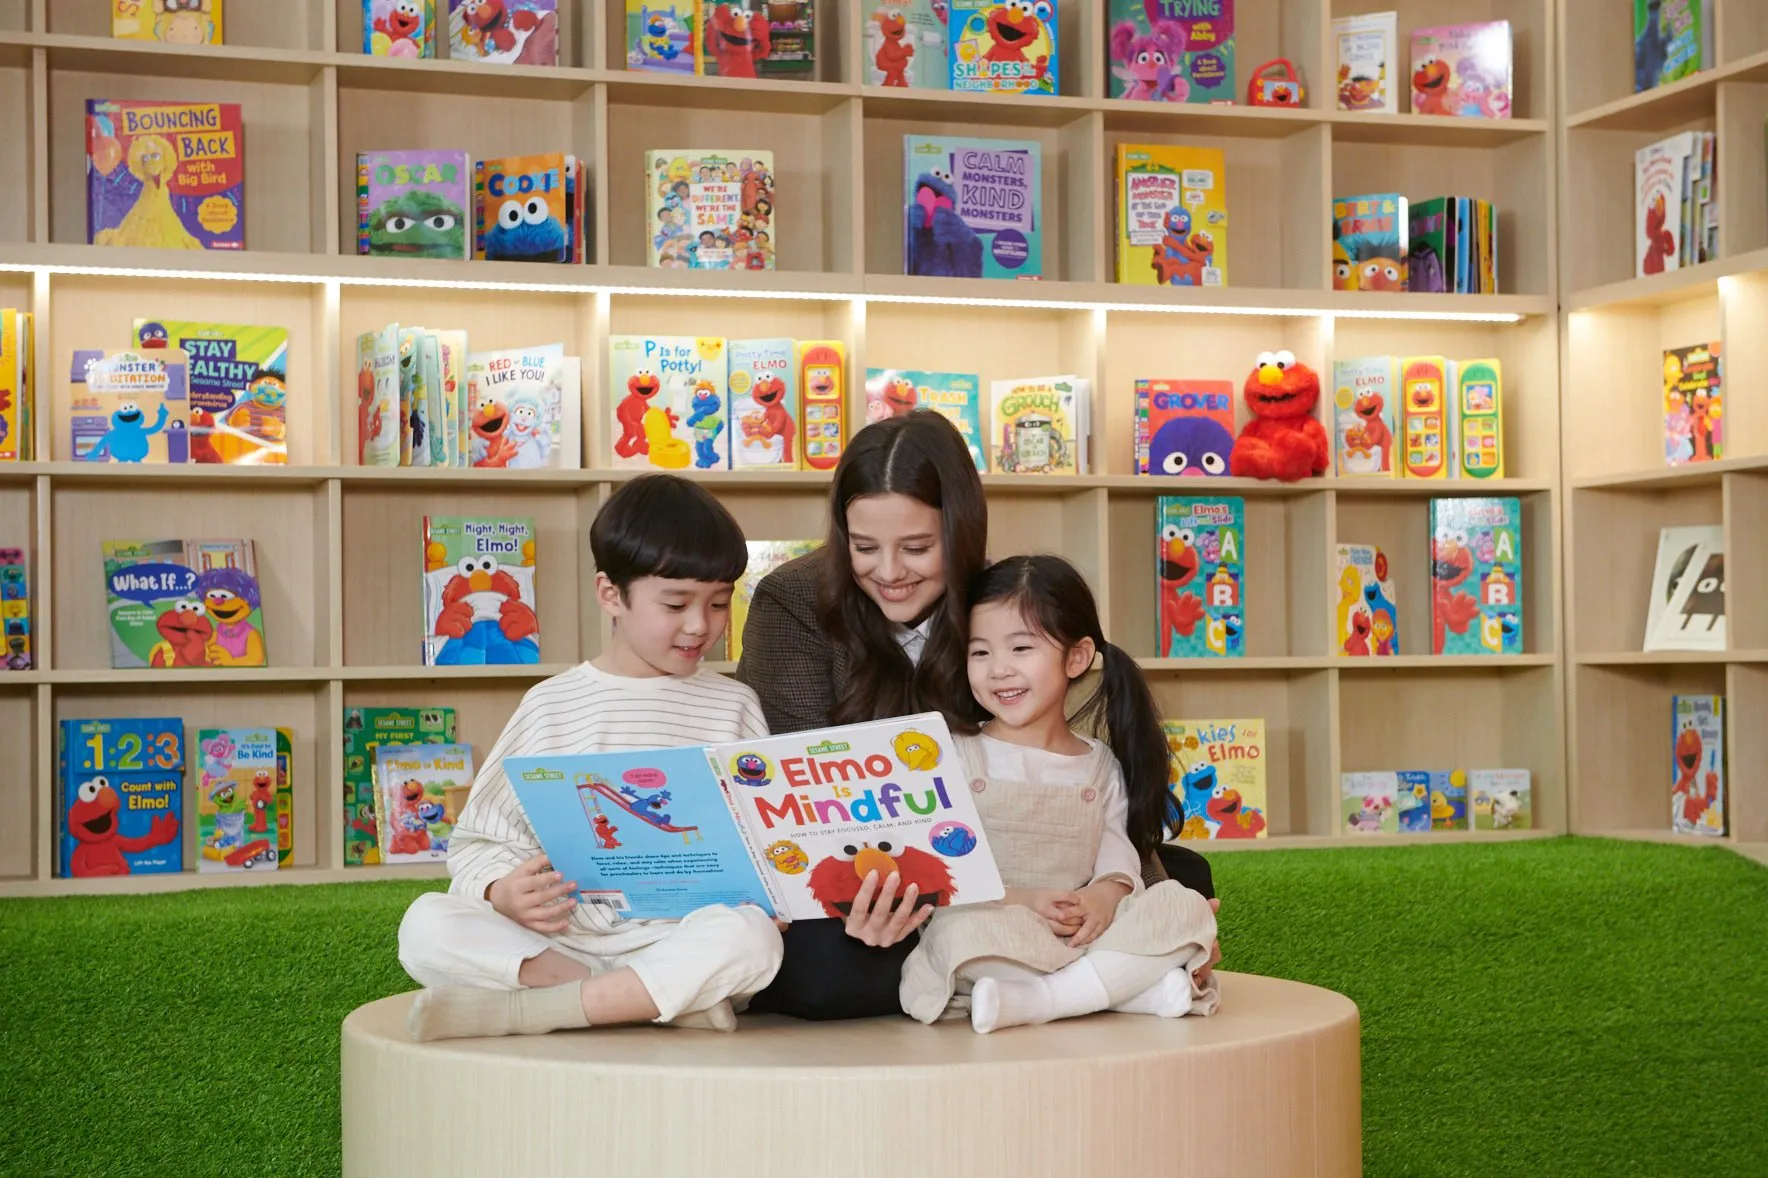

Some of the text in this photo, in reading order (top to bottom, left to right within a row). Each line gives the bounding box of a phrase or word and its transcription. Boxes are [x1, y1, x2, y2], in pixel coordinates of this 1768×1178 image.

[1159, 0, 1220, 17] TRYING
[955, 61, 1022, 78] SHAPES
[126, 109, 217, 132] BOUNCING
[181, 136, 230, 158] BACK
[186, 160, 216, 173] with
[963, 151, 1025, 175] CALM
[178, 171, 227, 187] Big Bird
[375, 163, 458, 186] OSCAR
[488, 168, 561, 198] COOKIE
[962, 171, 1028, 189] MONSTERS,
[691, 194, 740, 203] DIFFERENT
[961, 184, 1025, 211] KIND
[697, 213, 735, 225] SAME
[960, 208, 1024, 223] MONSTERS
[185, 340, 233, 358] STAY
[645, 340, 691, 358] P is for
[189, 359, 256, 380] EALTHY
[489, 358, 511, 372] RED
[522, 355, 545, 368] BLUE
[660, 358, 702, 375] Potty!
[753, 359, 787, 370] ELMO
[485, 368, 545, 387] I LIKE YOU!
[1356, 375, 1385, 387] ELMO
[918, 386, 968, 405] TRASH
[1153, 391, 1230, 411] GROVER
[1001, 393, 1061, 417] GROUCH
[1193, 504, 1229, 515] Elmo's
[465, 523, 528, 536] Night, Night,
[477, 538, 518, 553] Elmo!
[1221, 531, 1238, 560] A
[1496, 531, 1513, 561] A
[113, 572, 196, 592] What If...?
[1213, 584, 1233, 606] B
[1488, 583, 1509, 605] B
[1209, 620, 1223, 648] C
[1484, 618, 1499, 646] C
[118, 732, 143, 770] 2
[155, 731, 180, 770] 3
[237, 749, 274, 760] Be Kind
[1208, 743, 1260, 763] Elmo
[386, 759, 421, 772] Elmo
[433, 758, 465, 771] Kind
[780, 754, 893, 788] Elmo
[121, 781, 176, 793] Count with
[833, 785, 852, 799] Is
[128, 794, 169, 810] Elmo!
[754, 777, 953, 829] Mindful
